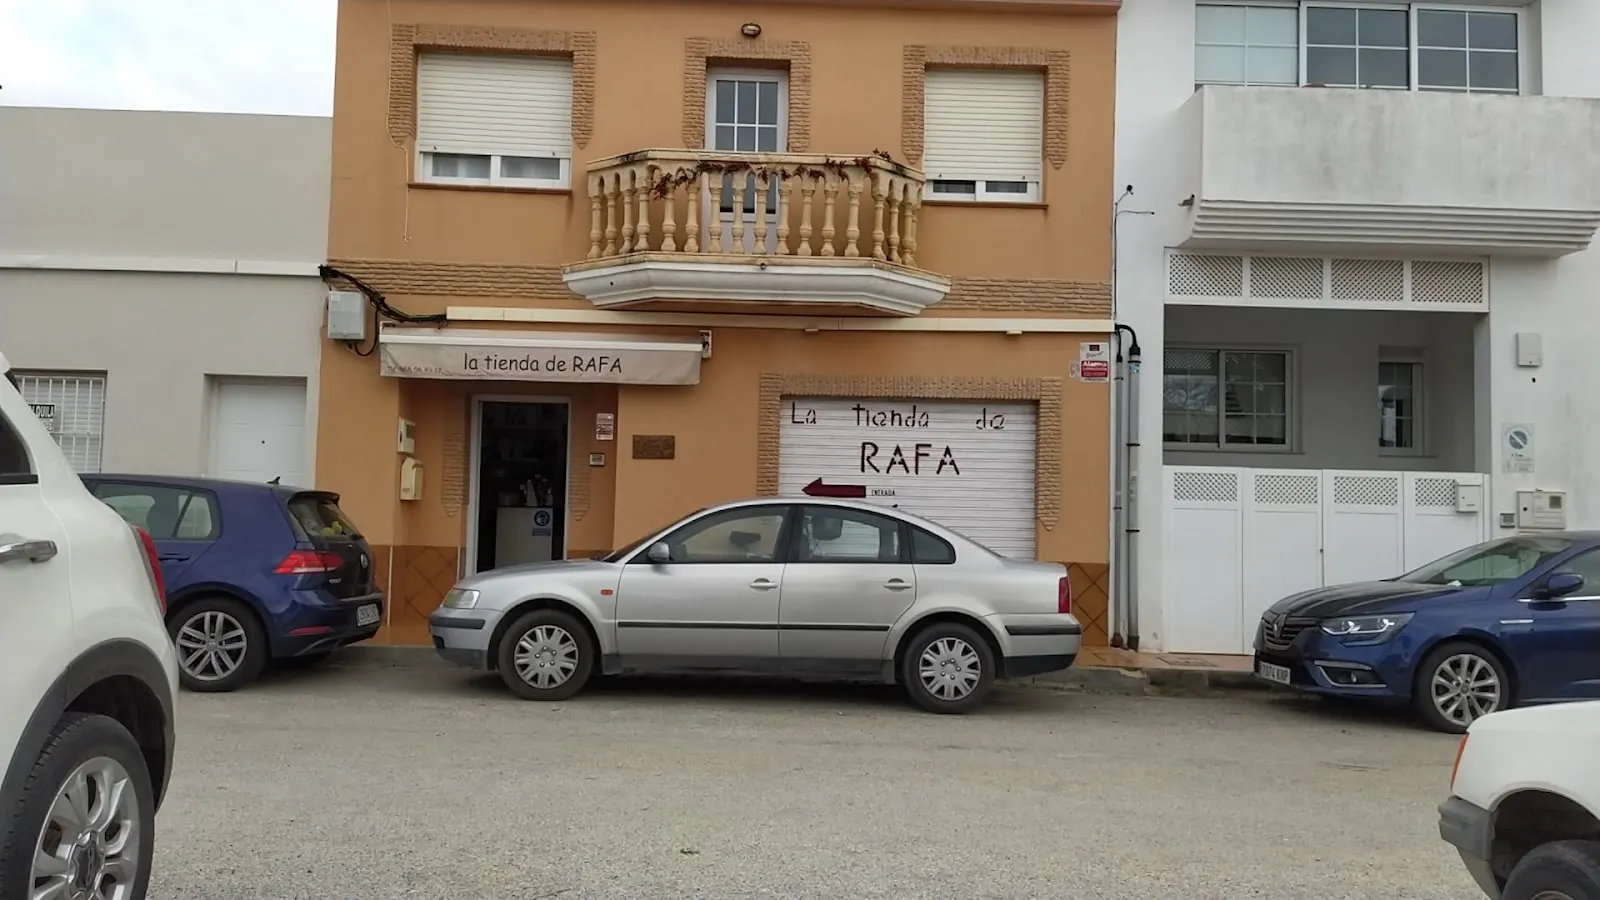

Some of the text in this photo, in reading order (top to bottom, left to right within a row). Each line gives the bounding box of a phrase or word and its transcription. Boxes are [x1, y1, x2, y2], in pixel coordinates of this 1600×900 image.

[464, 353, 622, 373] la tienda de RAFA
[792, 402, 816, 424] La
[976, 408, 1005, 430] de
[860, 442, 960, 475] RAFA
[871, 489, 896, 497] ENTRADA
